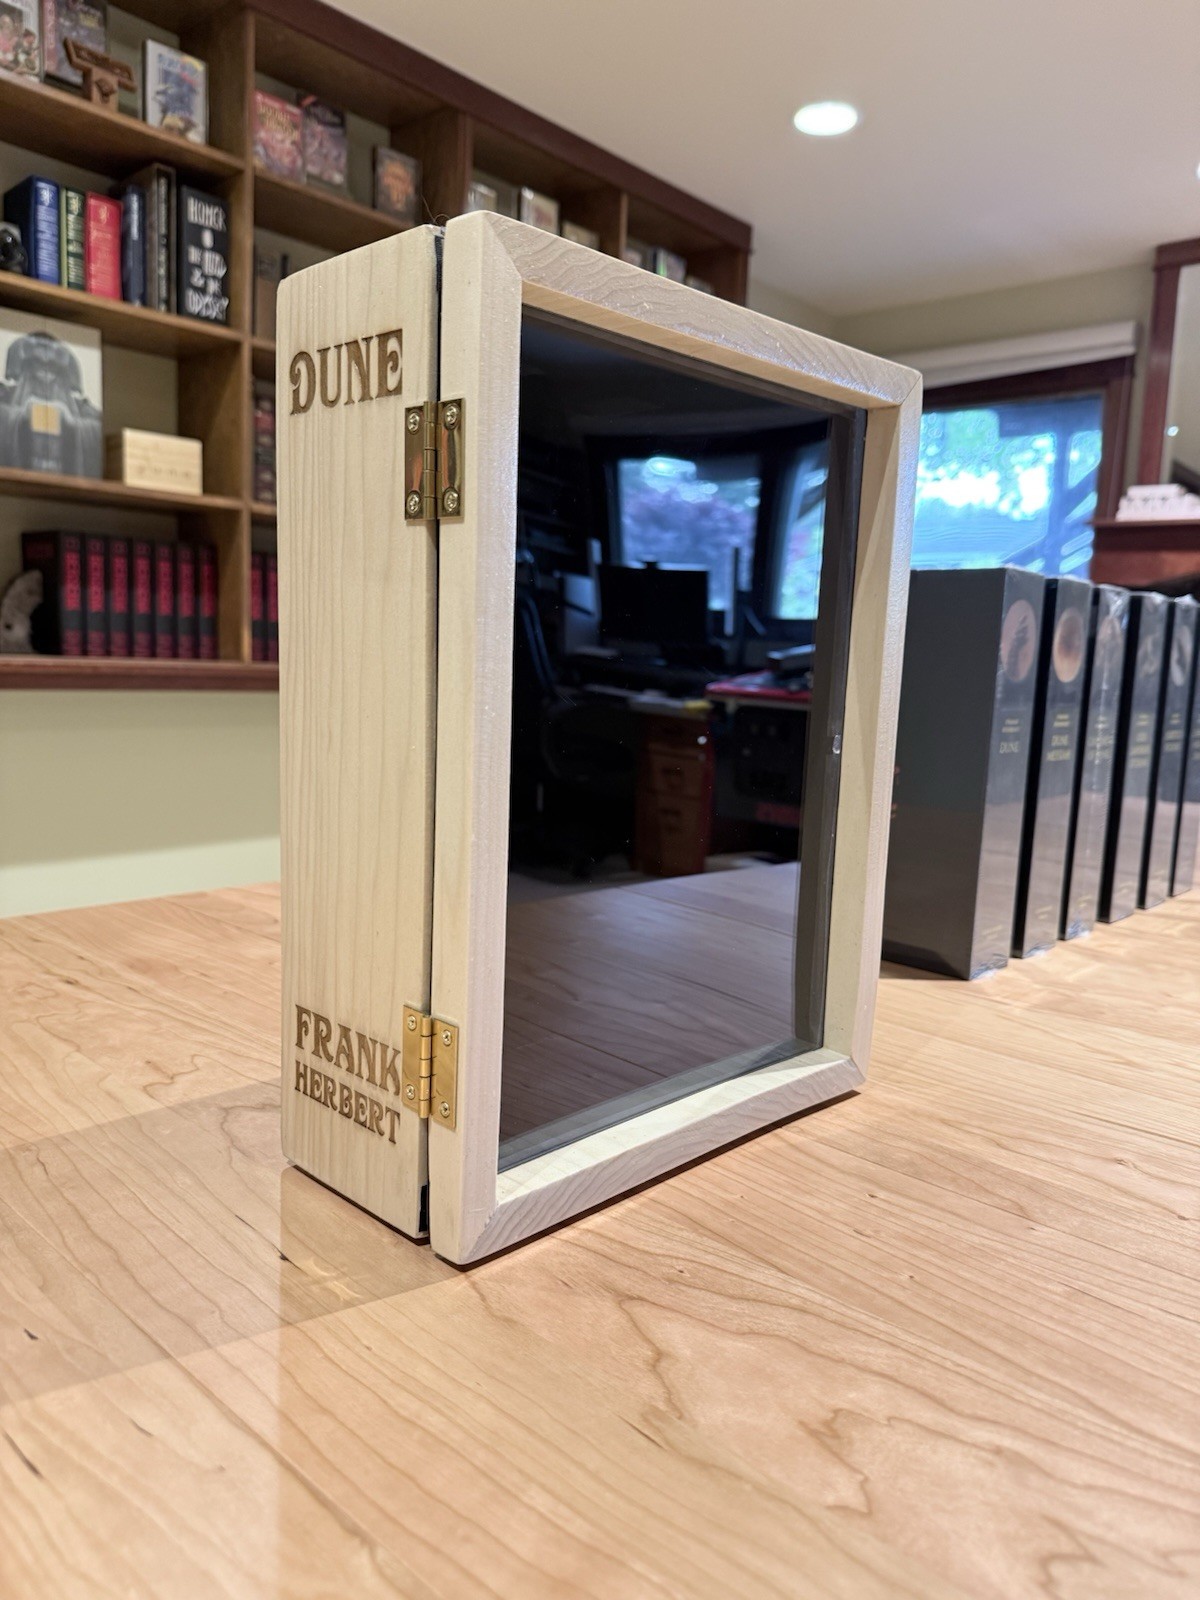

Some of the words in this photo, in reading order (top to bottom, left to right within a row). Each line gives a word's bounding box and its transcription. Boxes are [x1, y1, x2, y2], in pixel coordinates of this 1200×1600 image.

[289, 328, 403, 416] DUNE
[295, 1004, 401, 1096] FRANK
[295, 1060, 401, 1144] HERBERT
